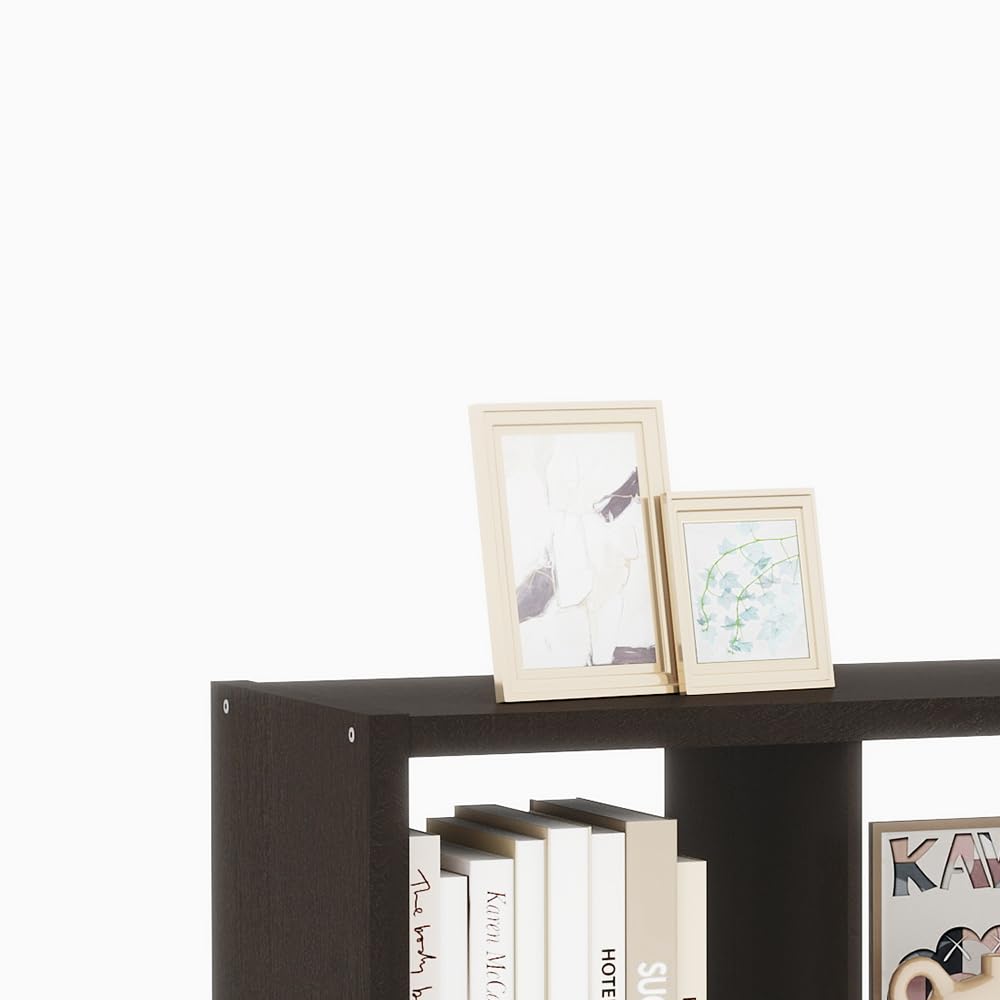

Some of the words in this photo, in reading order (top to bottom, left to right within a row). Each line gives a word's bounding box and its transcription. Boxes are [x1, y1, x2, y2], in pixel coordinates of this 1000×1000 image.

[410, 868, 431, 917] The
[486, 890, 507, 944] Karen
[410, 924, 437, 975] body
